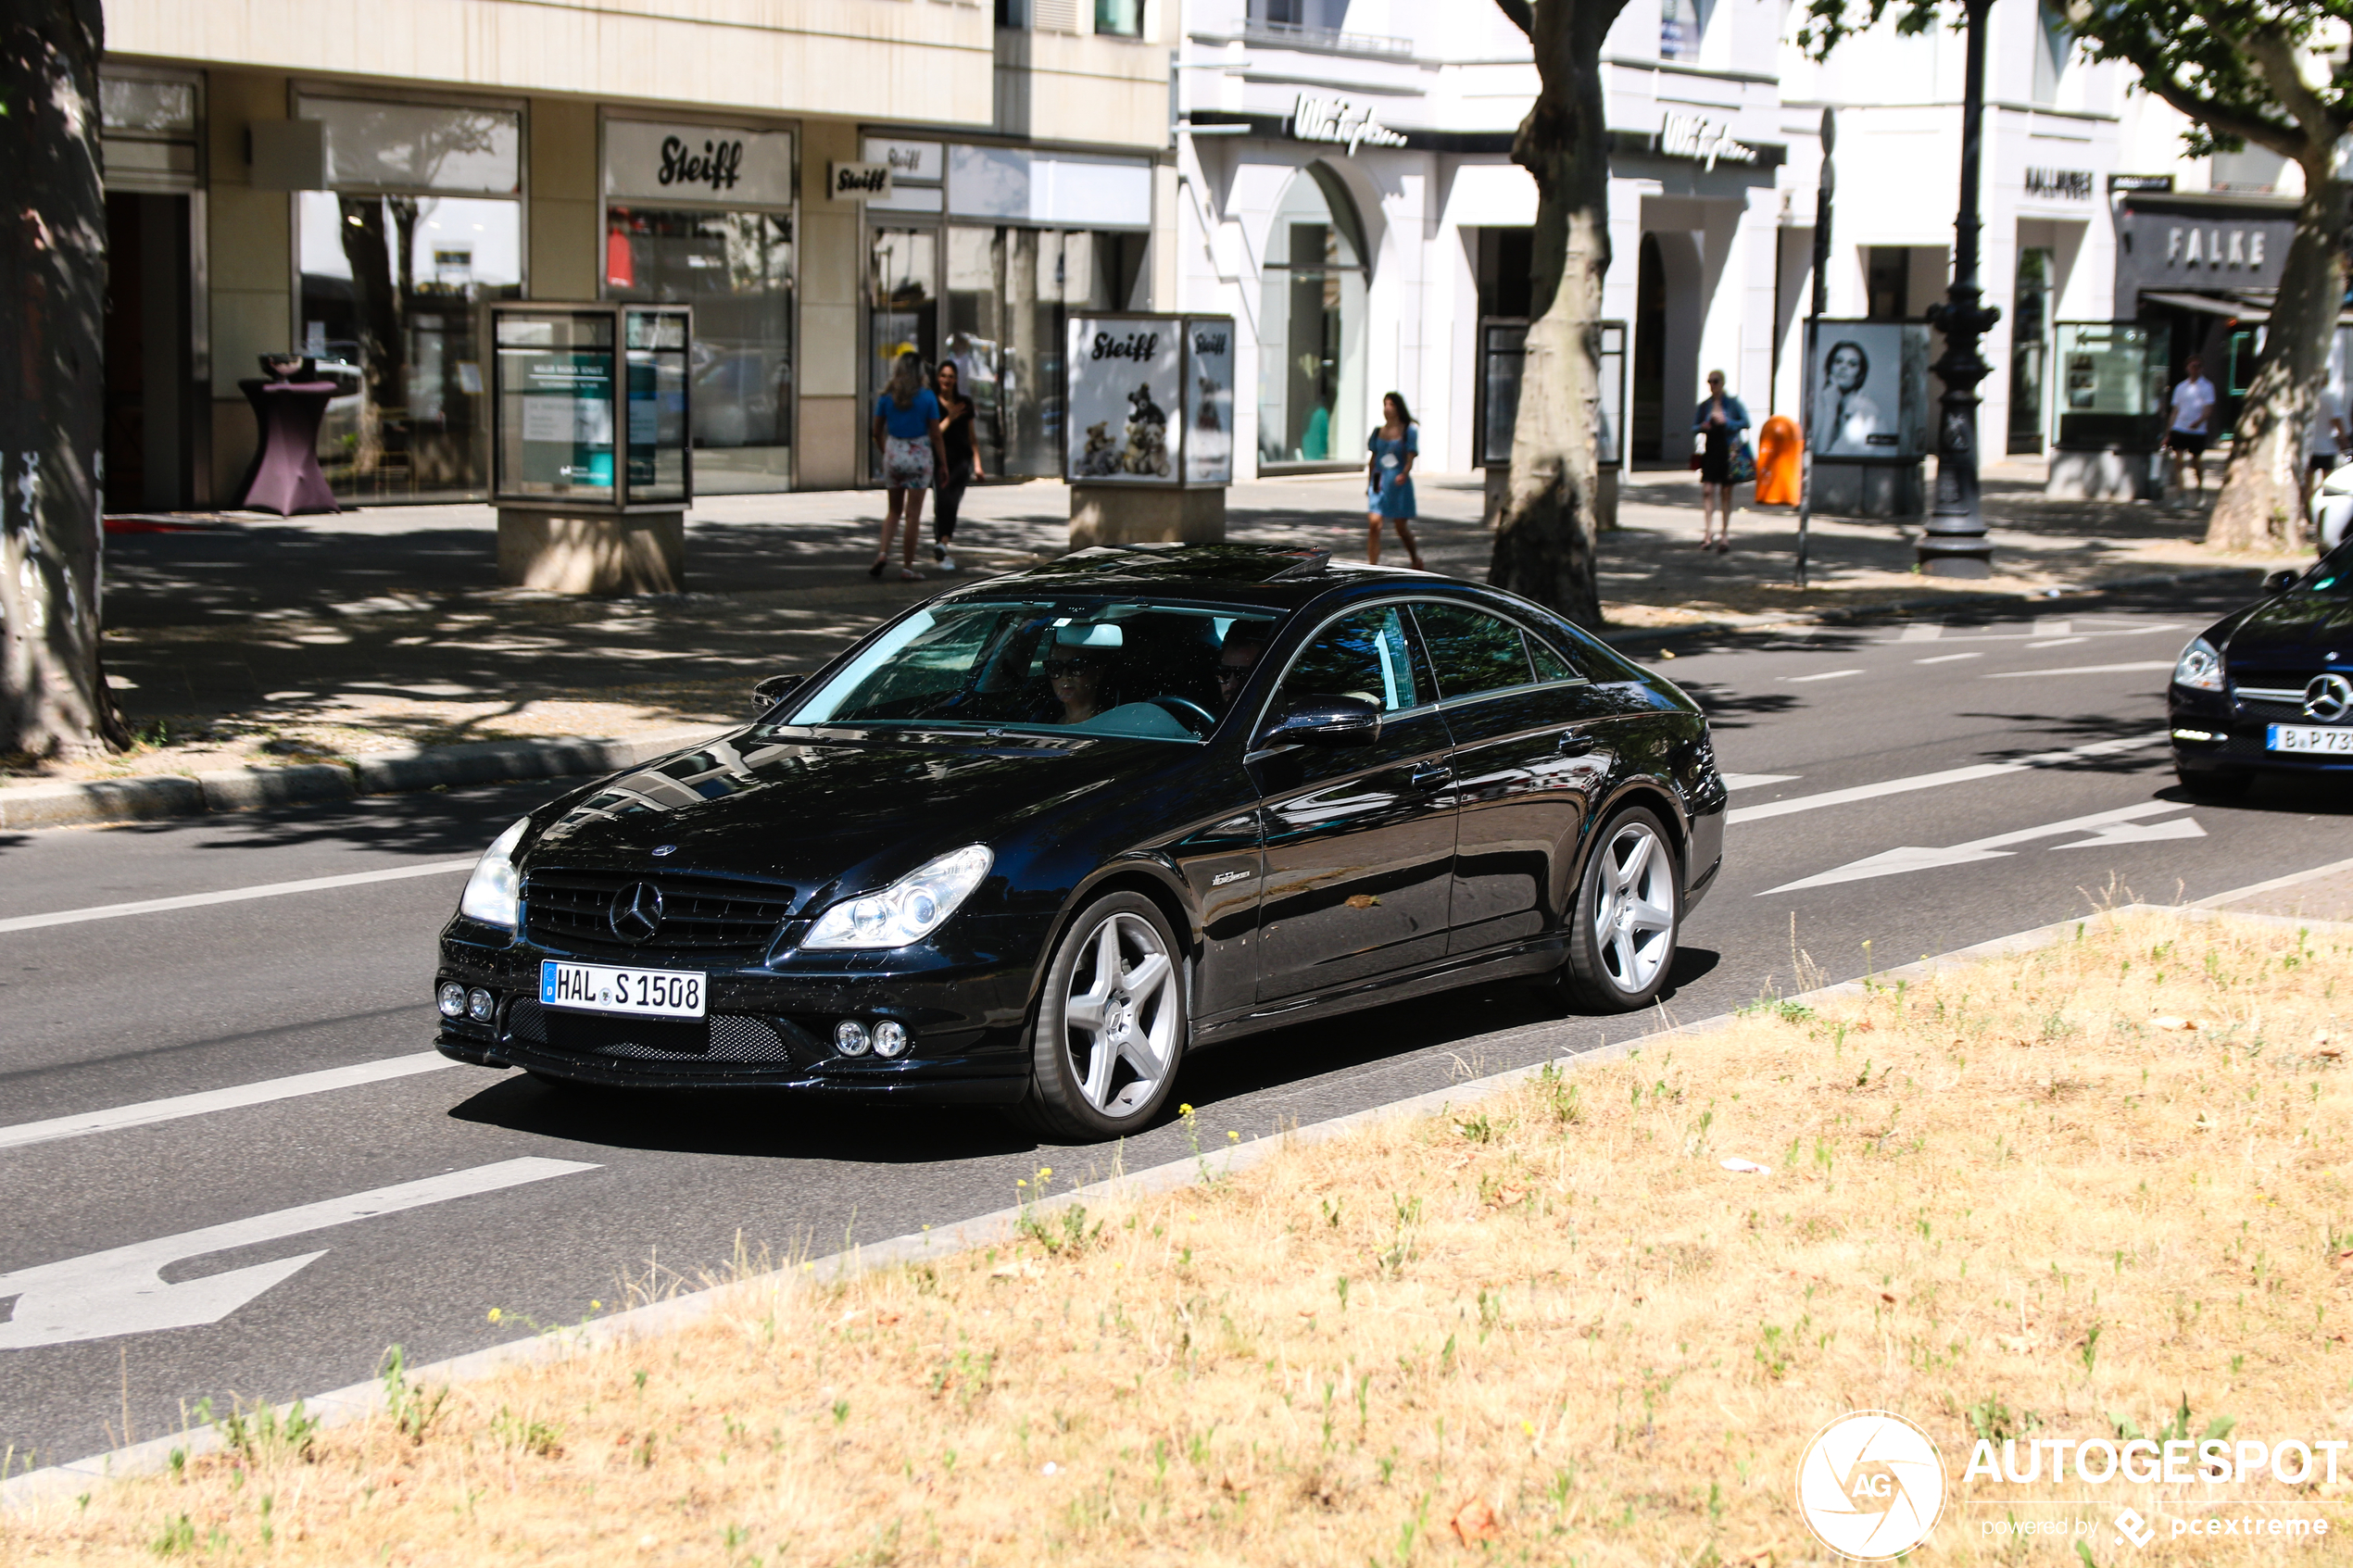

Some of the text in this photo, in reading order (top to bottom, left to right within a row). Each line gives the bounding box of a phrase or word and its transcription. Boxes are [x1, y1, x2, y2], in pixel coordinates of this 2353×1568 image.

[659, 135, 742, 190] Steiff
[888, 146, 922, 170] Steiff
[837, 168, 887, 192] Steiff
[2168, 226, 2266, 264] FALKE
[1092, 331, 1158, 362] Steiff
[1195, 332, 1227, 355] Steiff
[2286, 731, 2353, 750] B P 73
[547, 986, 553, 996] D
[558, 969, 698, 1010] HAL S 1508
